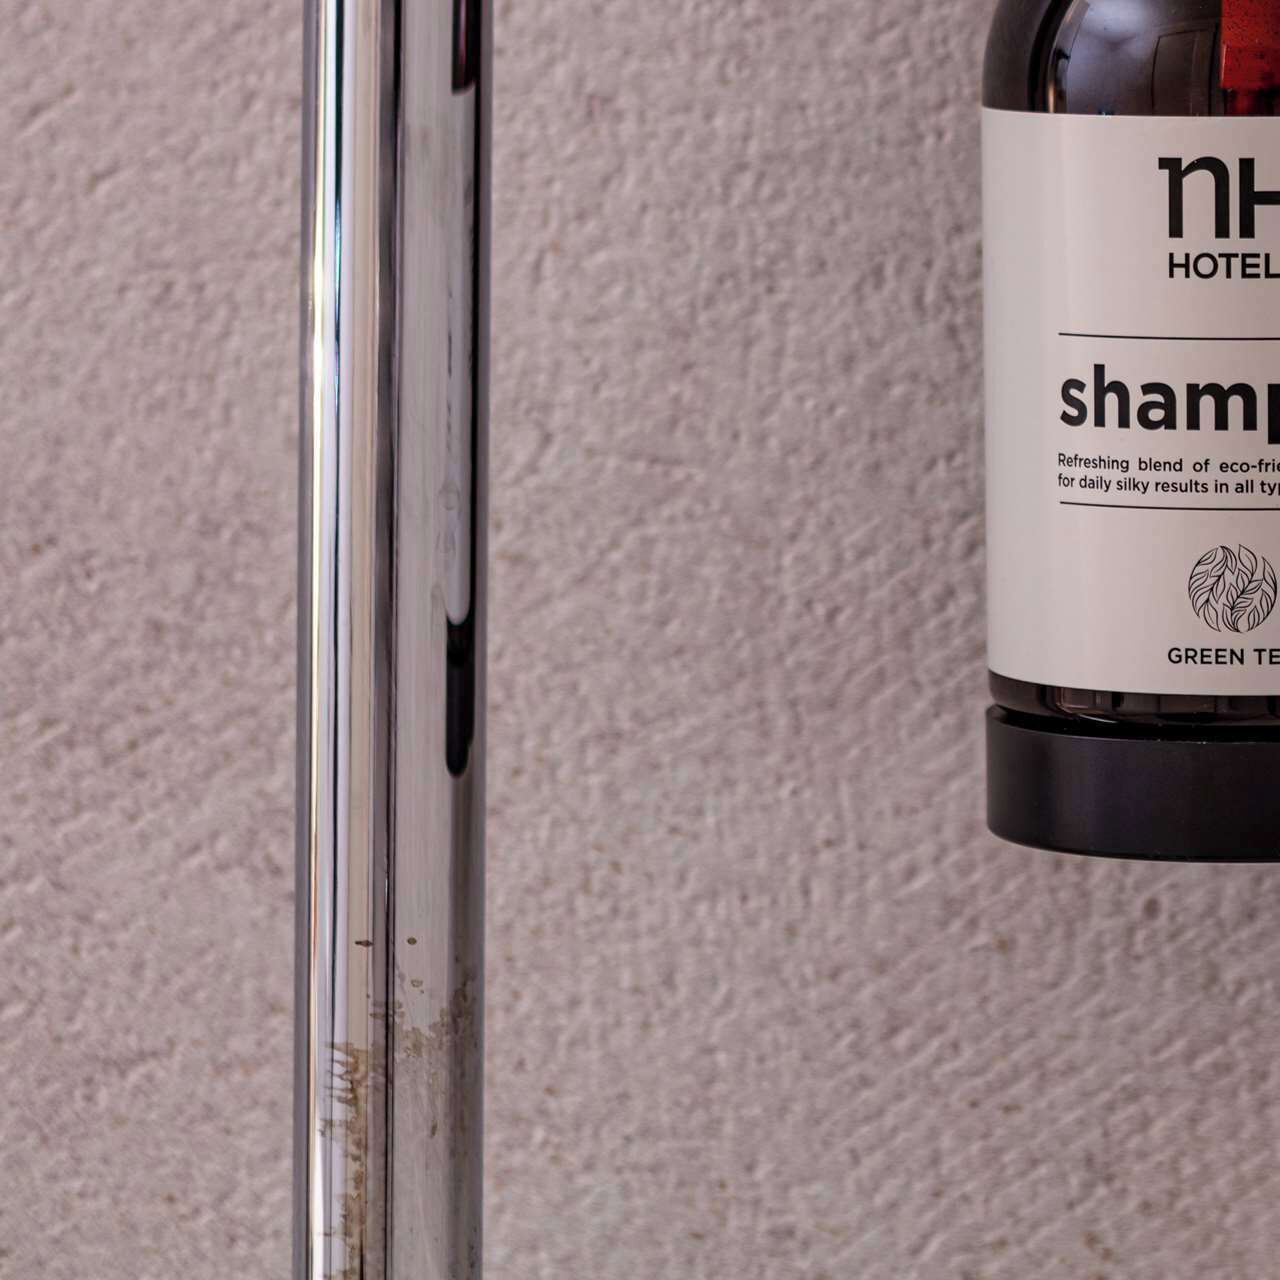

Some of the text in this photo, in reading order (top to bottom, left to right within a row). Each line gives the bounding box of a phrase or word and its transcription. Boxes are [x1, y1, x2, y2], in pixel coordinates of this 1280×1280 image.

[1057, 452, 1130, 474] Refreshing
[1137, 456, 1184, 473] blend
[1191, 457, 1211, 474] of
[1057, 472, 1076, 488] for
[1078, 474, 1113, 493] daily
[1115, 476, 1151, 495] silky
[1154, 478, 1209, 494] results
[1214, 478, 1230, 494] in
[1234, 478, 1255, 494] all
[1167, 646, 1245, 666] GREEN
